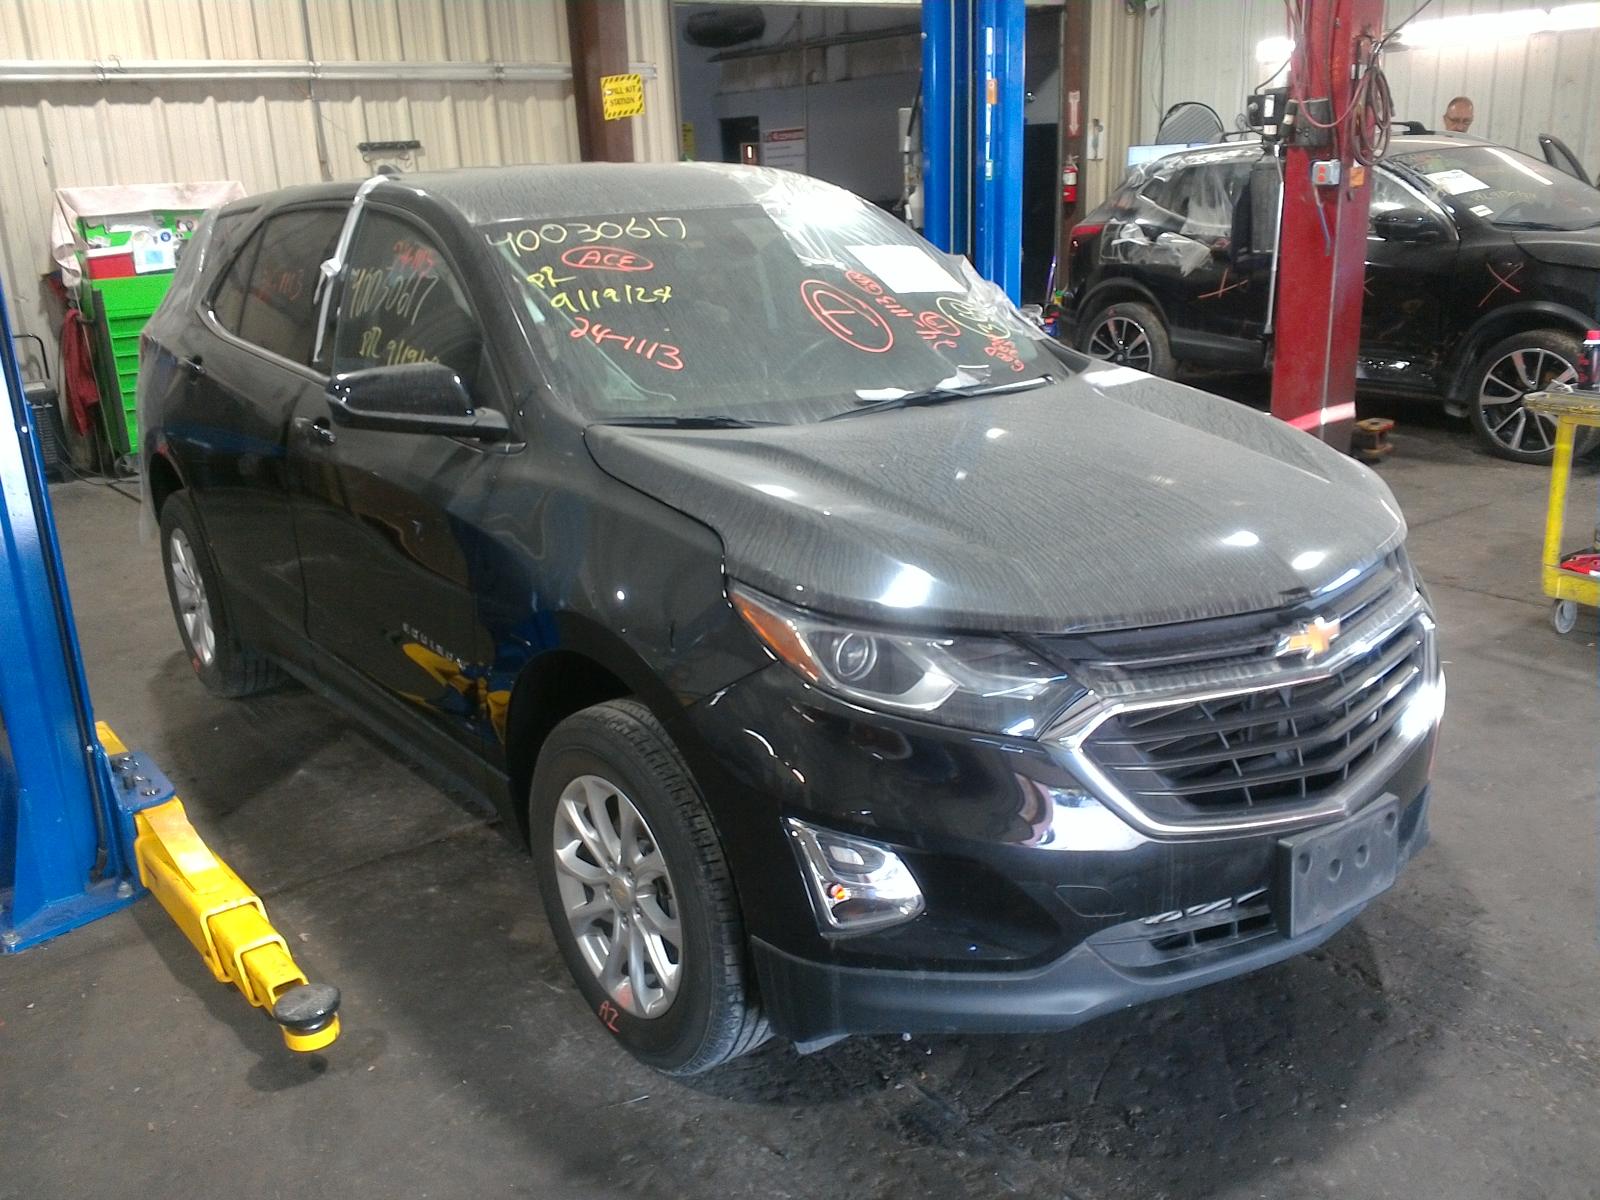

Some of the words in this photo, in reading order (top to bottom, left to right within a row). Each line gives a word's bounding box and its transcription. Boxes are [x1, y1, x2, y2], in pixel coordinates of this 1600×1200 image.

[484, 217, 687, 257] 40030617
[577, 250, 637, 268] ACE
[569, 316, 684, 371] 24-1113
